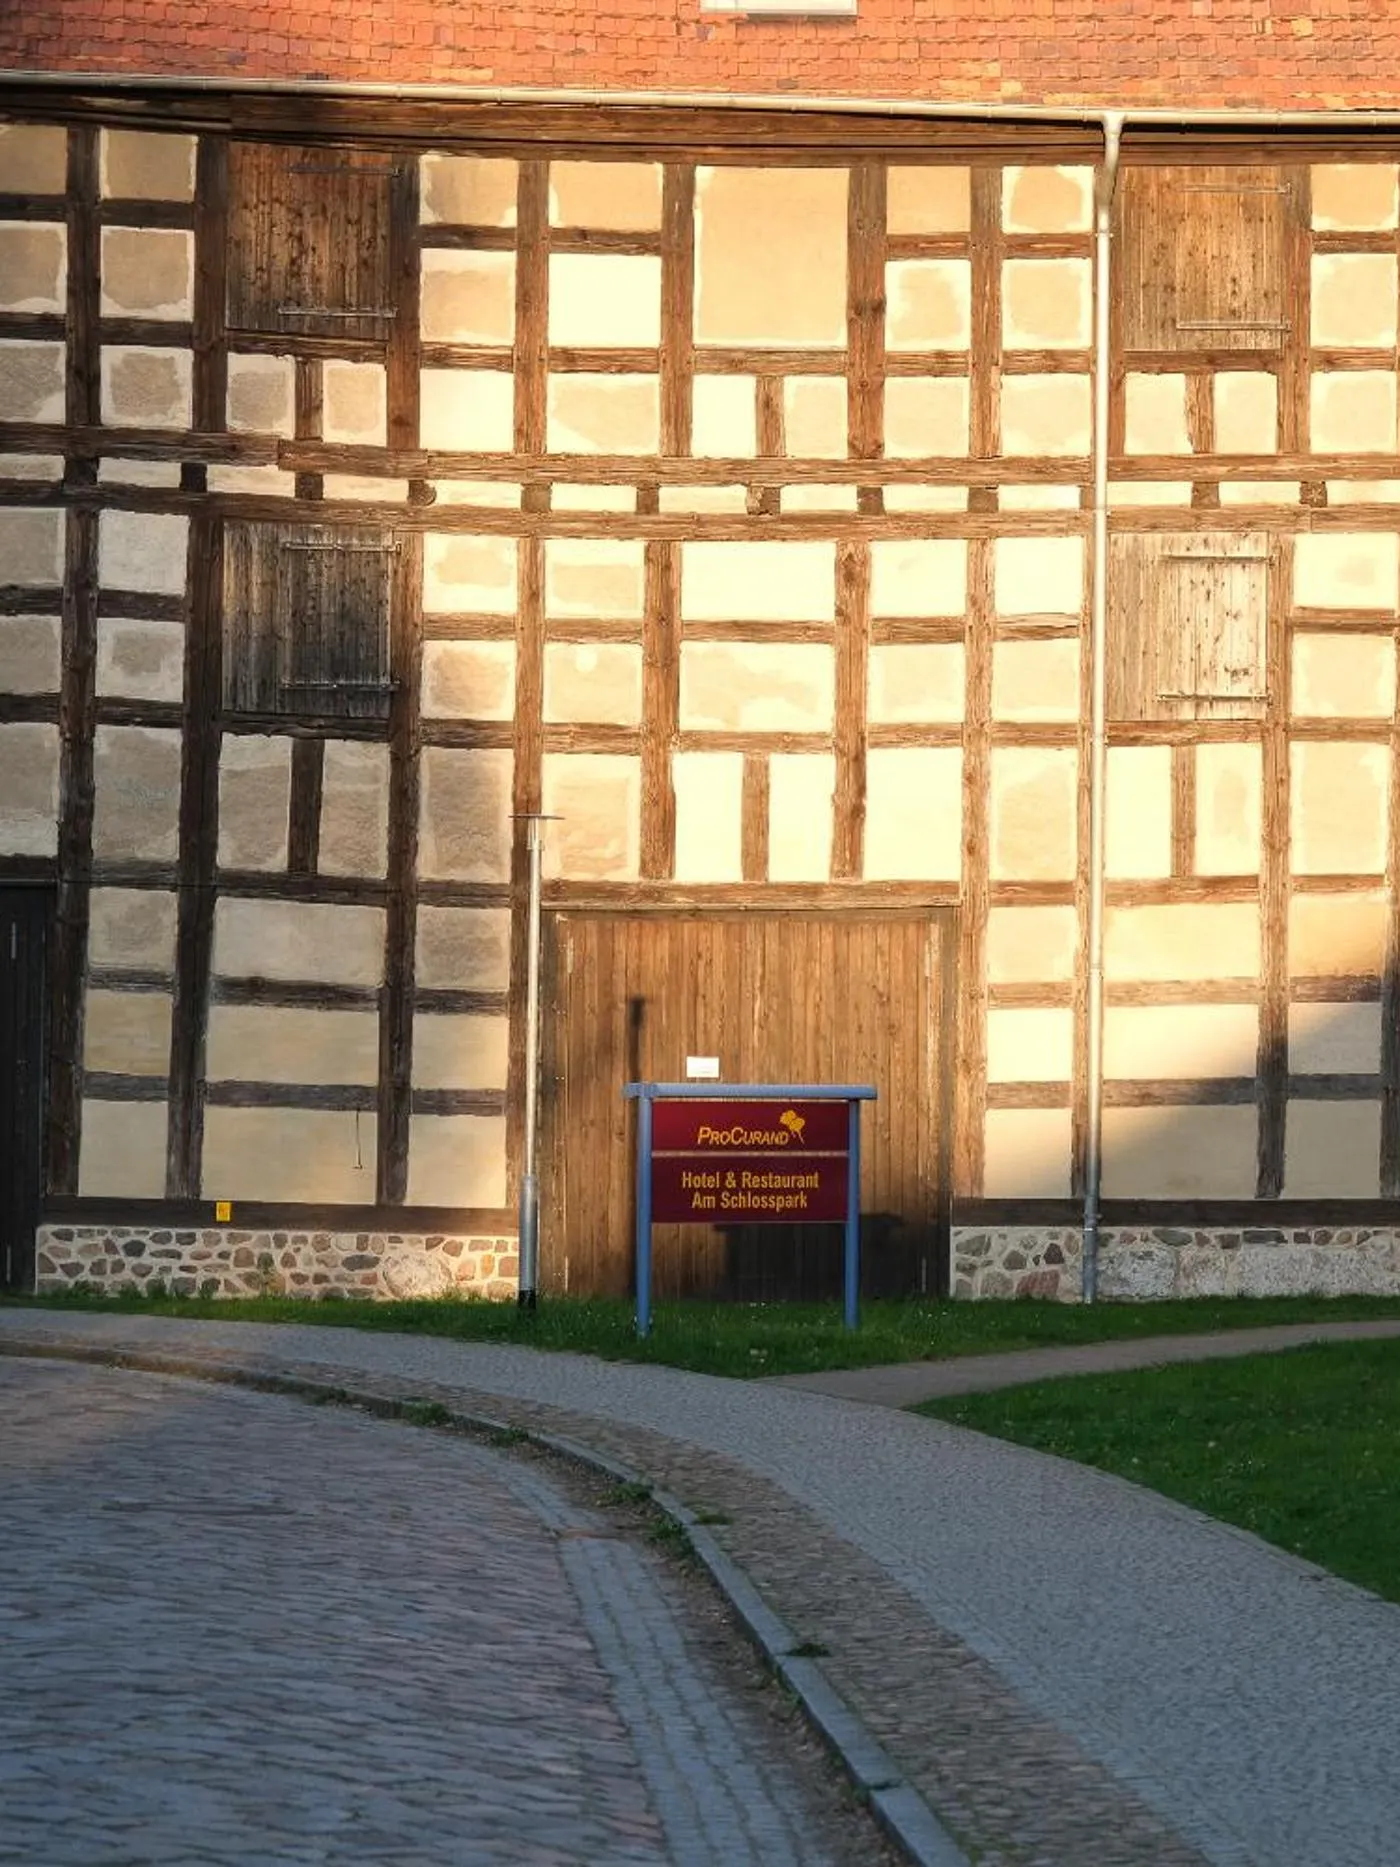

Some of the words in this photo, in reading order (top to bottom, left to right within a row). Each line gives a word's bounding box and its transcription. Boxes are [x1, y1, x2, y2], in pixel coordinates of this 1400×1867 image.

[682, 1171, 720, 1189] Hotel
[725, 1172, 737, 1189] &
[742, 1171, 820, 1189] Restaurant
[692, 1191, 716, 1209] Am
[720, 1191, 808, 1213] Schlosspark
